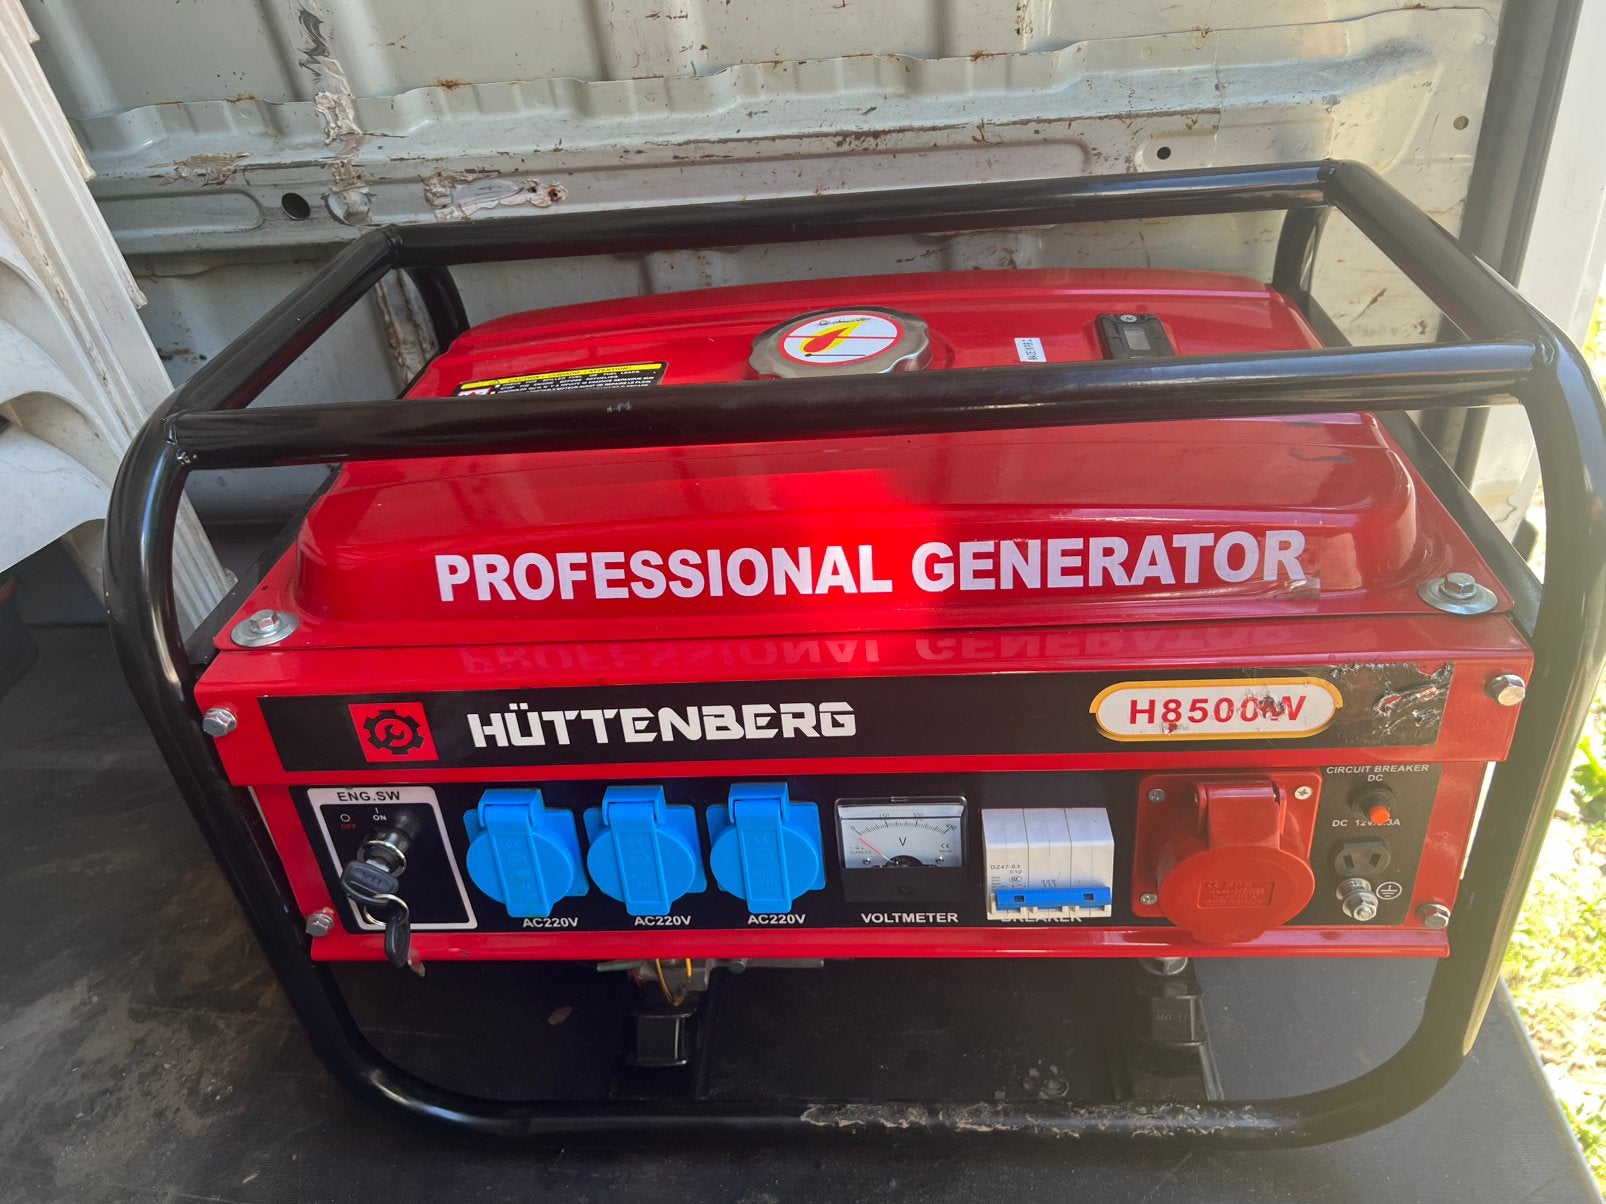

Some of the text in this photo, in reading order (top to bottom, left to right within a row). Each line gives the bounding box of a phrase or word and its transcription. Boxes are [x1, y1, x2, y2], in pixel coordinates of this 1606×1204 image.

[435, 529, 1306, 601] PROFESSIONAL GENERATOR
[467, 701, 857, 748] HÜTTENBERG
[1326, 764, 1430, 774] CIRCUIT BREAKER
[1367, 774, 1383, 782] DC
[337, 791, 400, 801] ENG.SW
[1332, 819, 1349, 827] DC
[899, 837, 907, 846] V
[522, 917, 579, 928] AC220V
[634, 915, 691, 926] AC220V
[747, 913, 806, 924] AC220V
[861, 912, 959, 923] VOLTMETER
